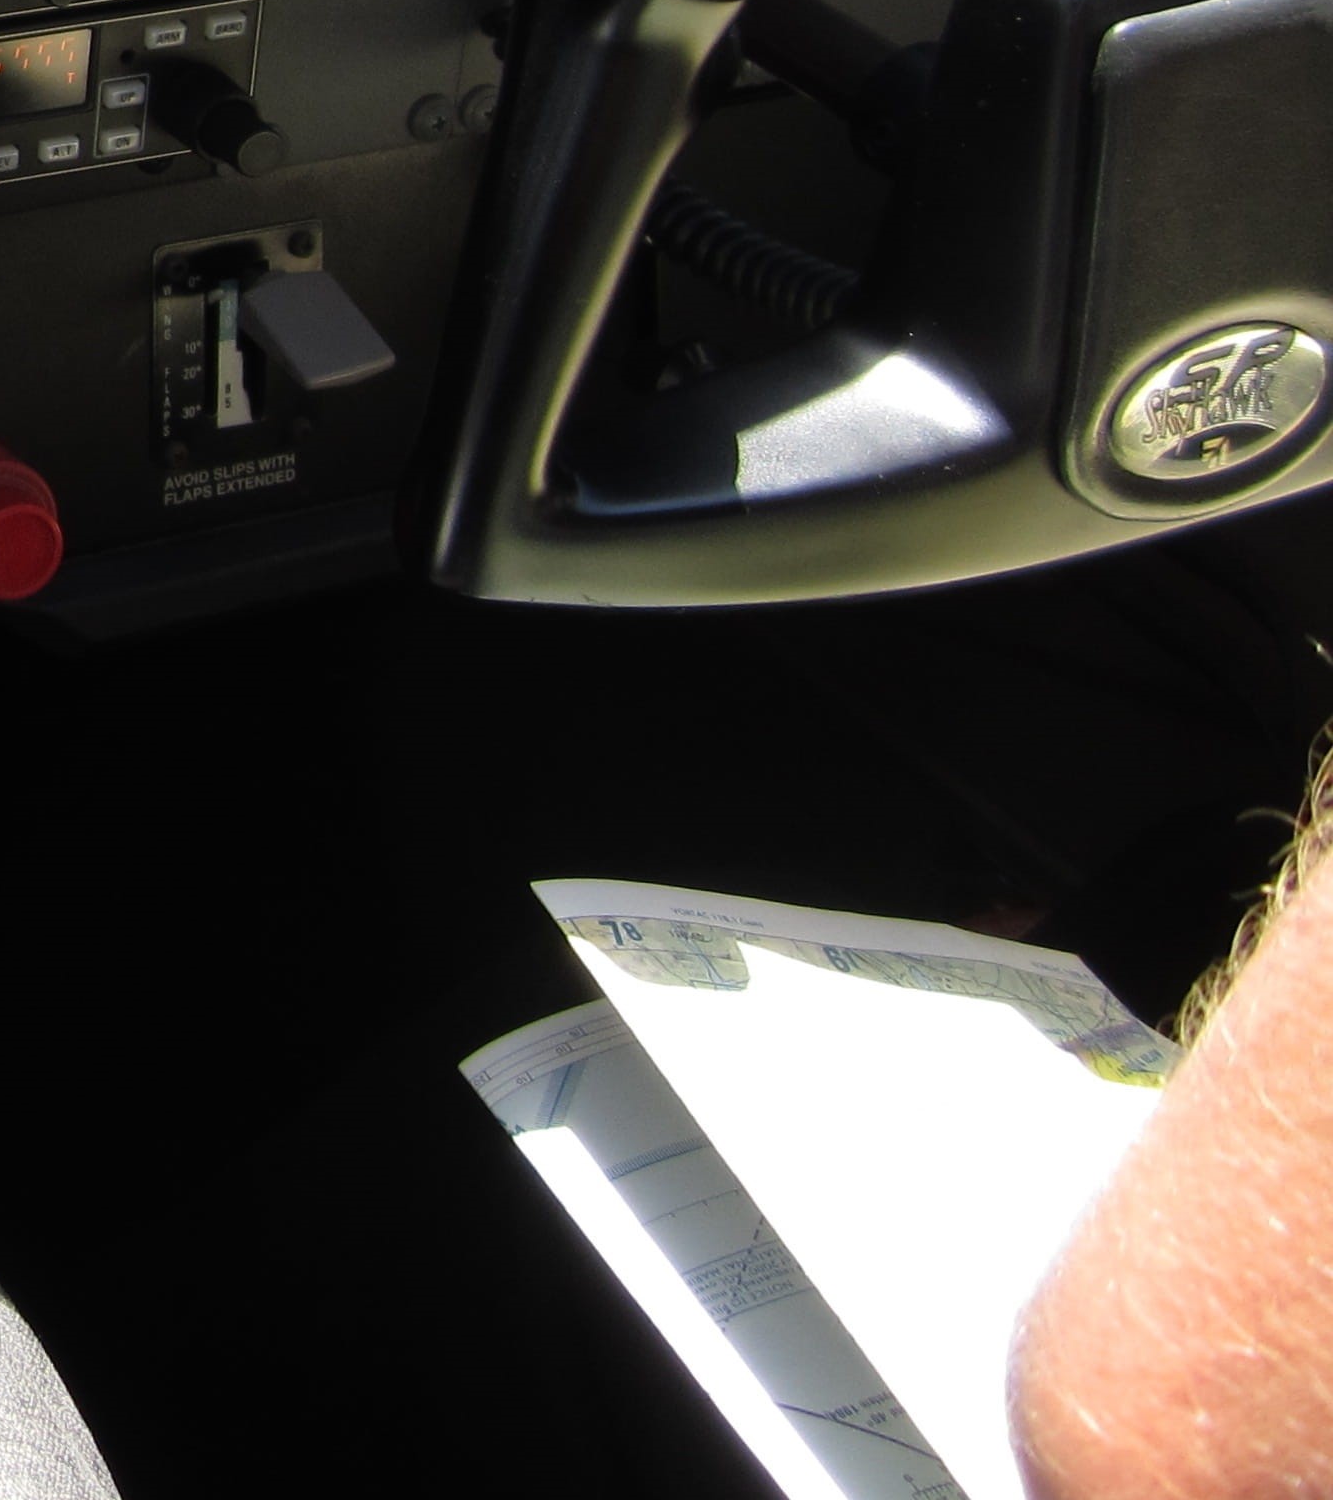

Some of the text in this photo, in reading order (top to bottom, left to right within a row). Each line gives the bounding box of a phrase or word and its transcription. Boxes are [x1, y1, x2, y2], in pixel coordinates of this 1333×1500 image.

[164, 470, 296, 506] FLAPS EXTENDED
[165, 453, 296, 490] AVOID SLIPS WITH
